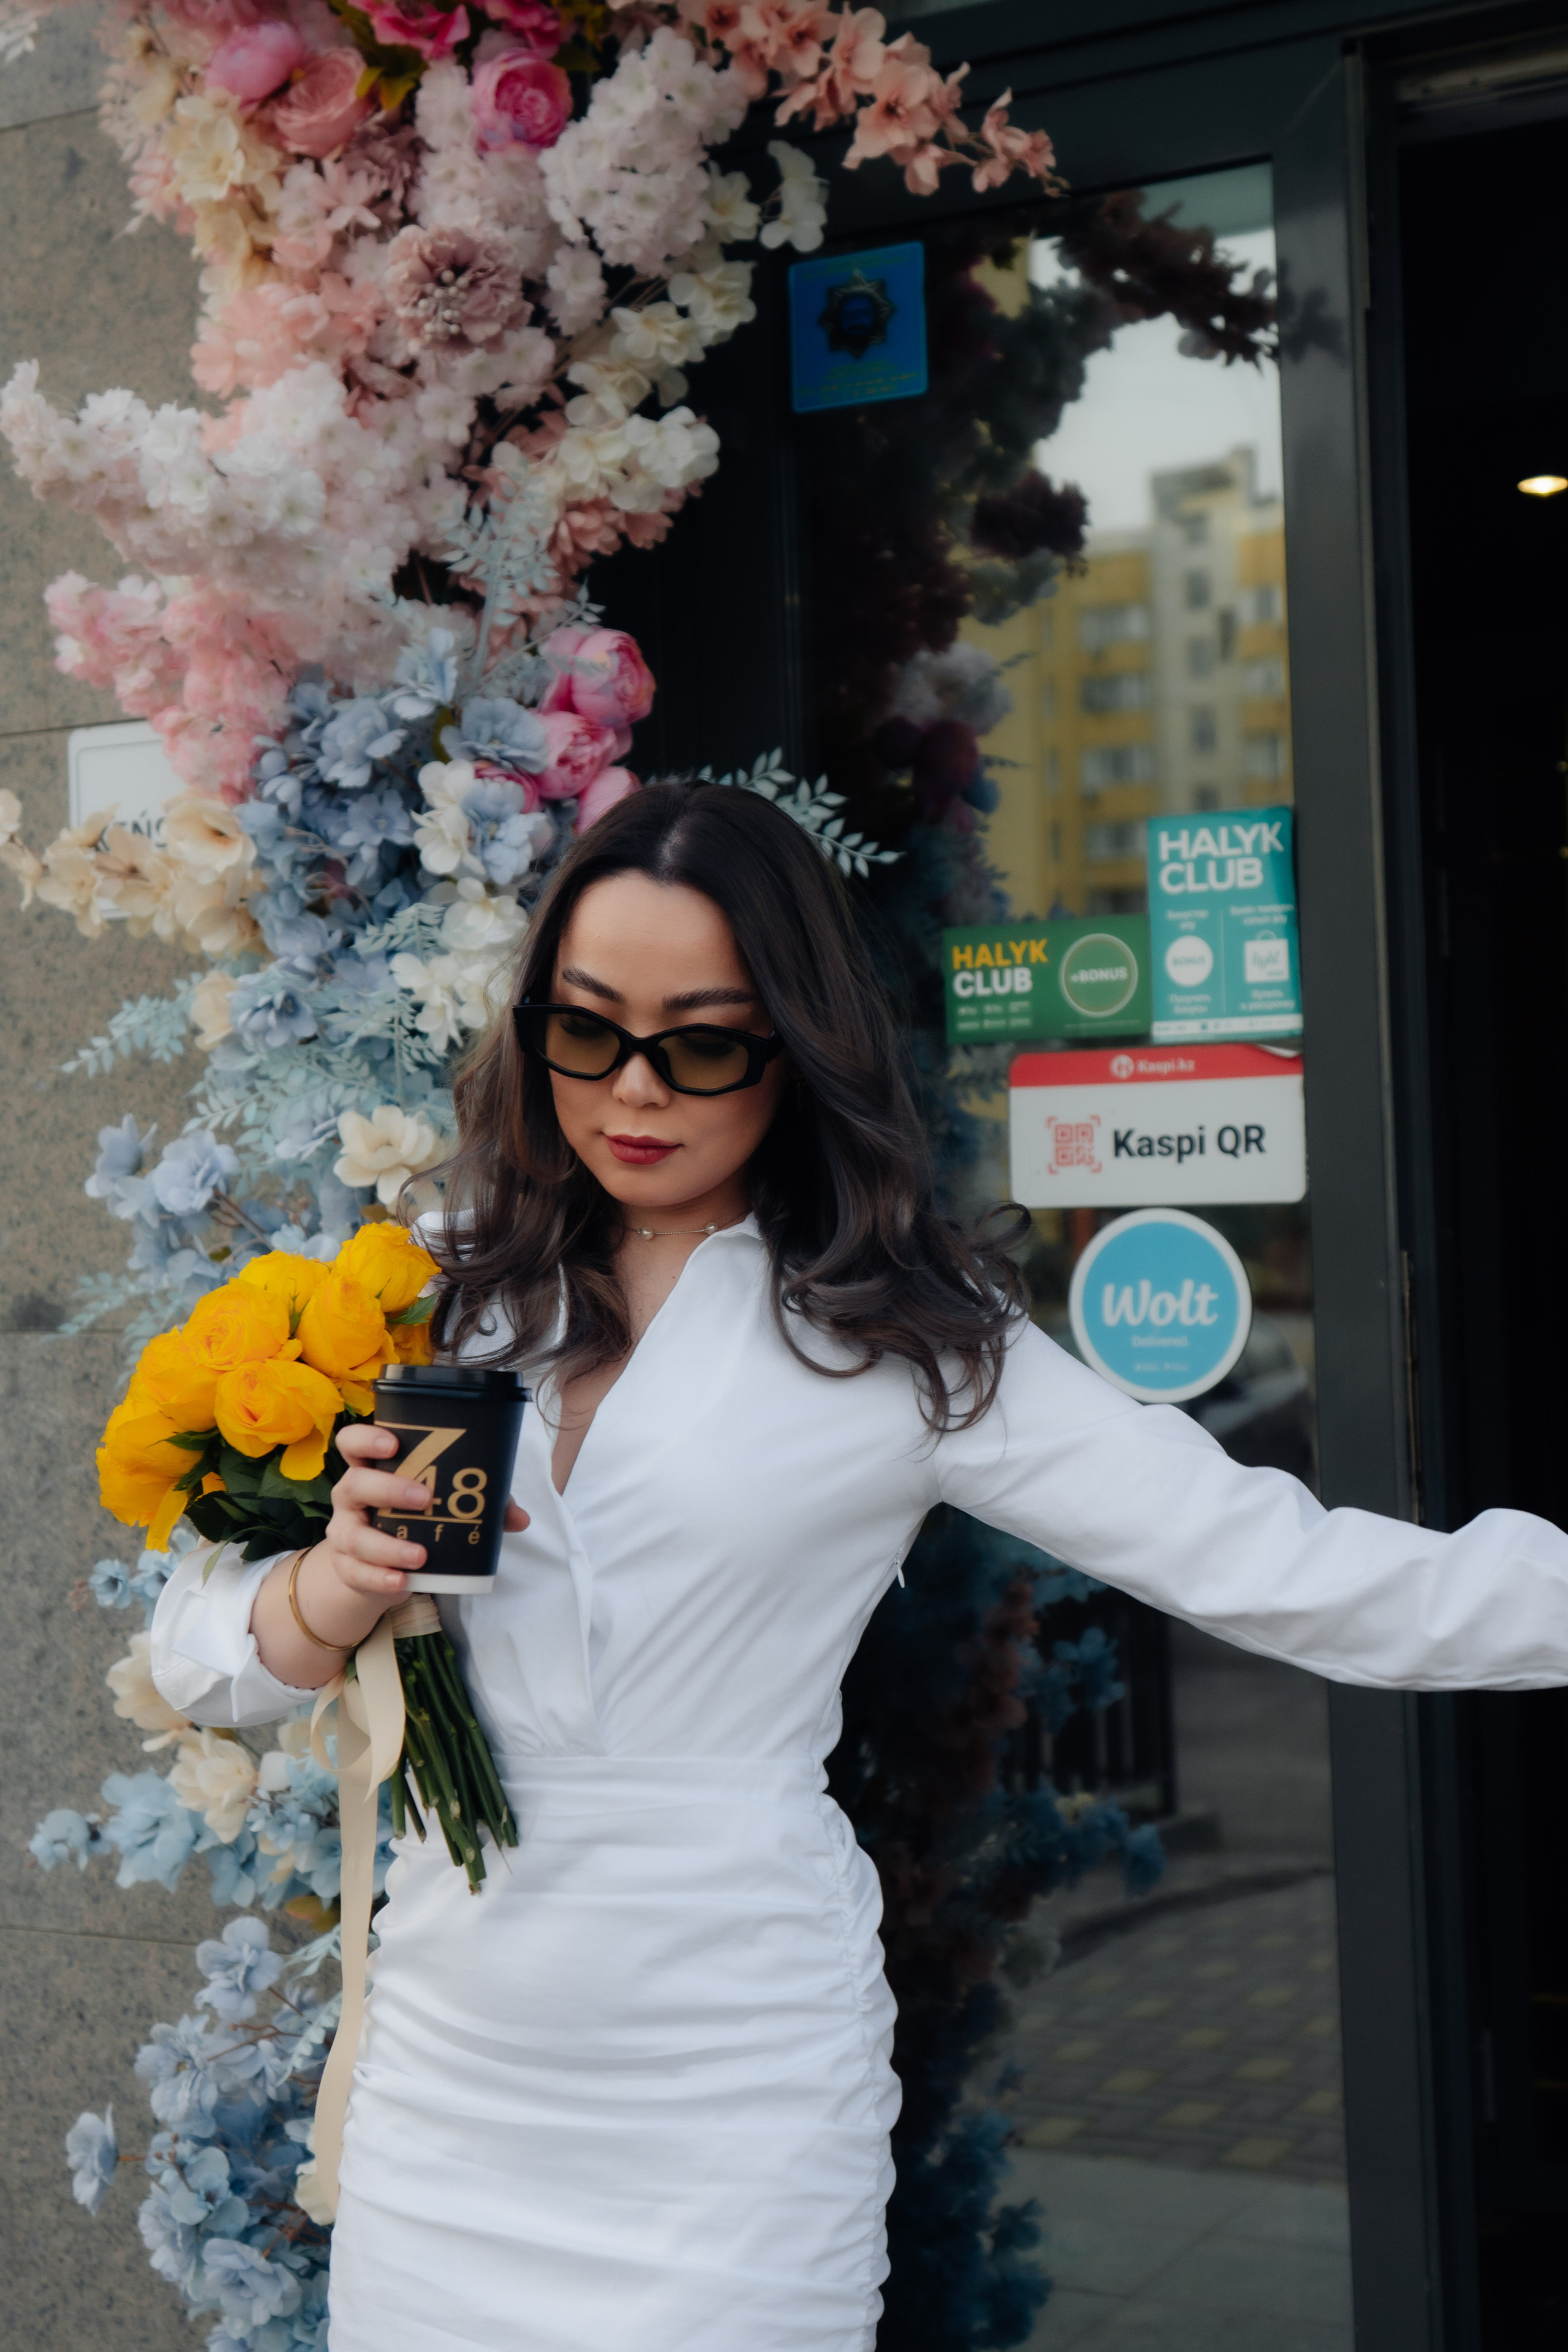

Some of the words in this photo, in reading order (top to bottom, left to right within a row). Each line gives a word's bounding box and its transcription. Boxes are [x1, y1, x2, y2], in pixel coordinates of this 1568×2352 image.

[1159, 822, 1284, 861] HALYK
[1159, 857, 1264, 894] CLUB
[953, 939, 1049, 970] HALYK
[953, 967, 1033, 998] CLUB
[1114, 1126, 1205, 1163] Kaspi
[1217, 1125, 1265, 1158] QR
[1102, 1278, 1219, 1327] Wolt
